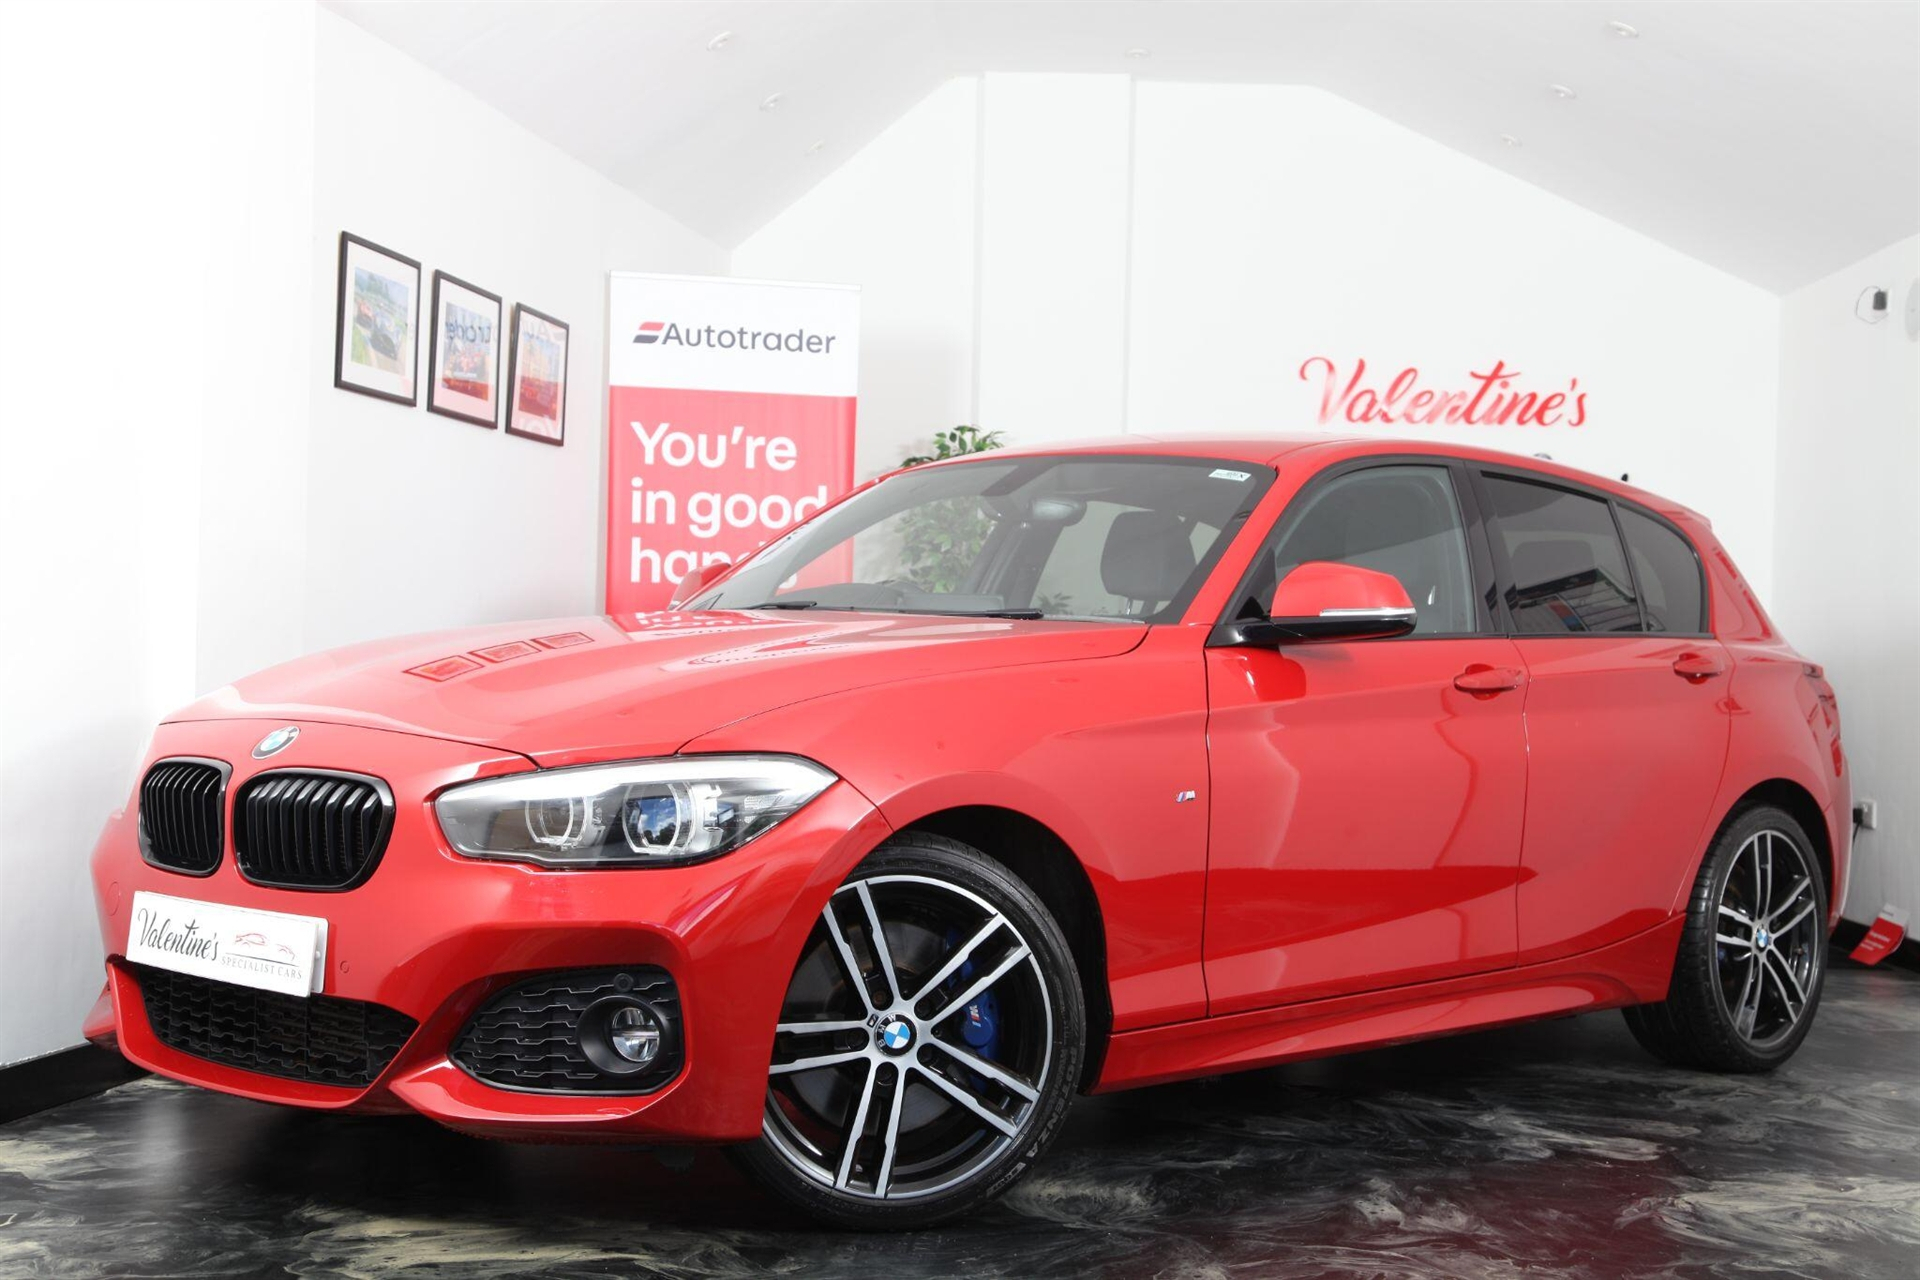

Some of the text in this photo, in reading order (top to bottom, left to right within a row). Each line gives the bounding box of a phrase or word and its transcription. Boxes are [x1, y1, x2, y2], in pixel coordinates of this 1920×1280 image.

[661, 322, 836, 354] Autotrader
[1299, 356, 1587, 427] Valentine's
[630, 421, 797, 471] You're
[631, 476, 676, 525] in
[138, 908, 219, 961] Valentine's
[221, 956, 302, 980] SPECIALIST CARS
